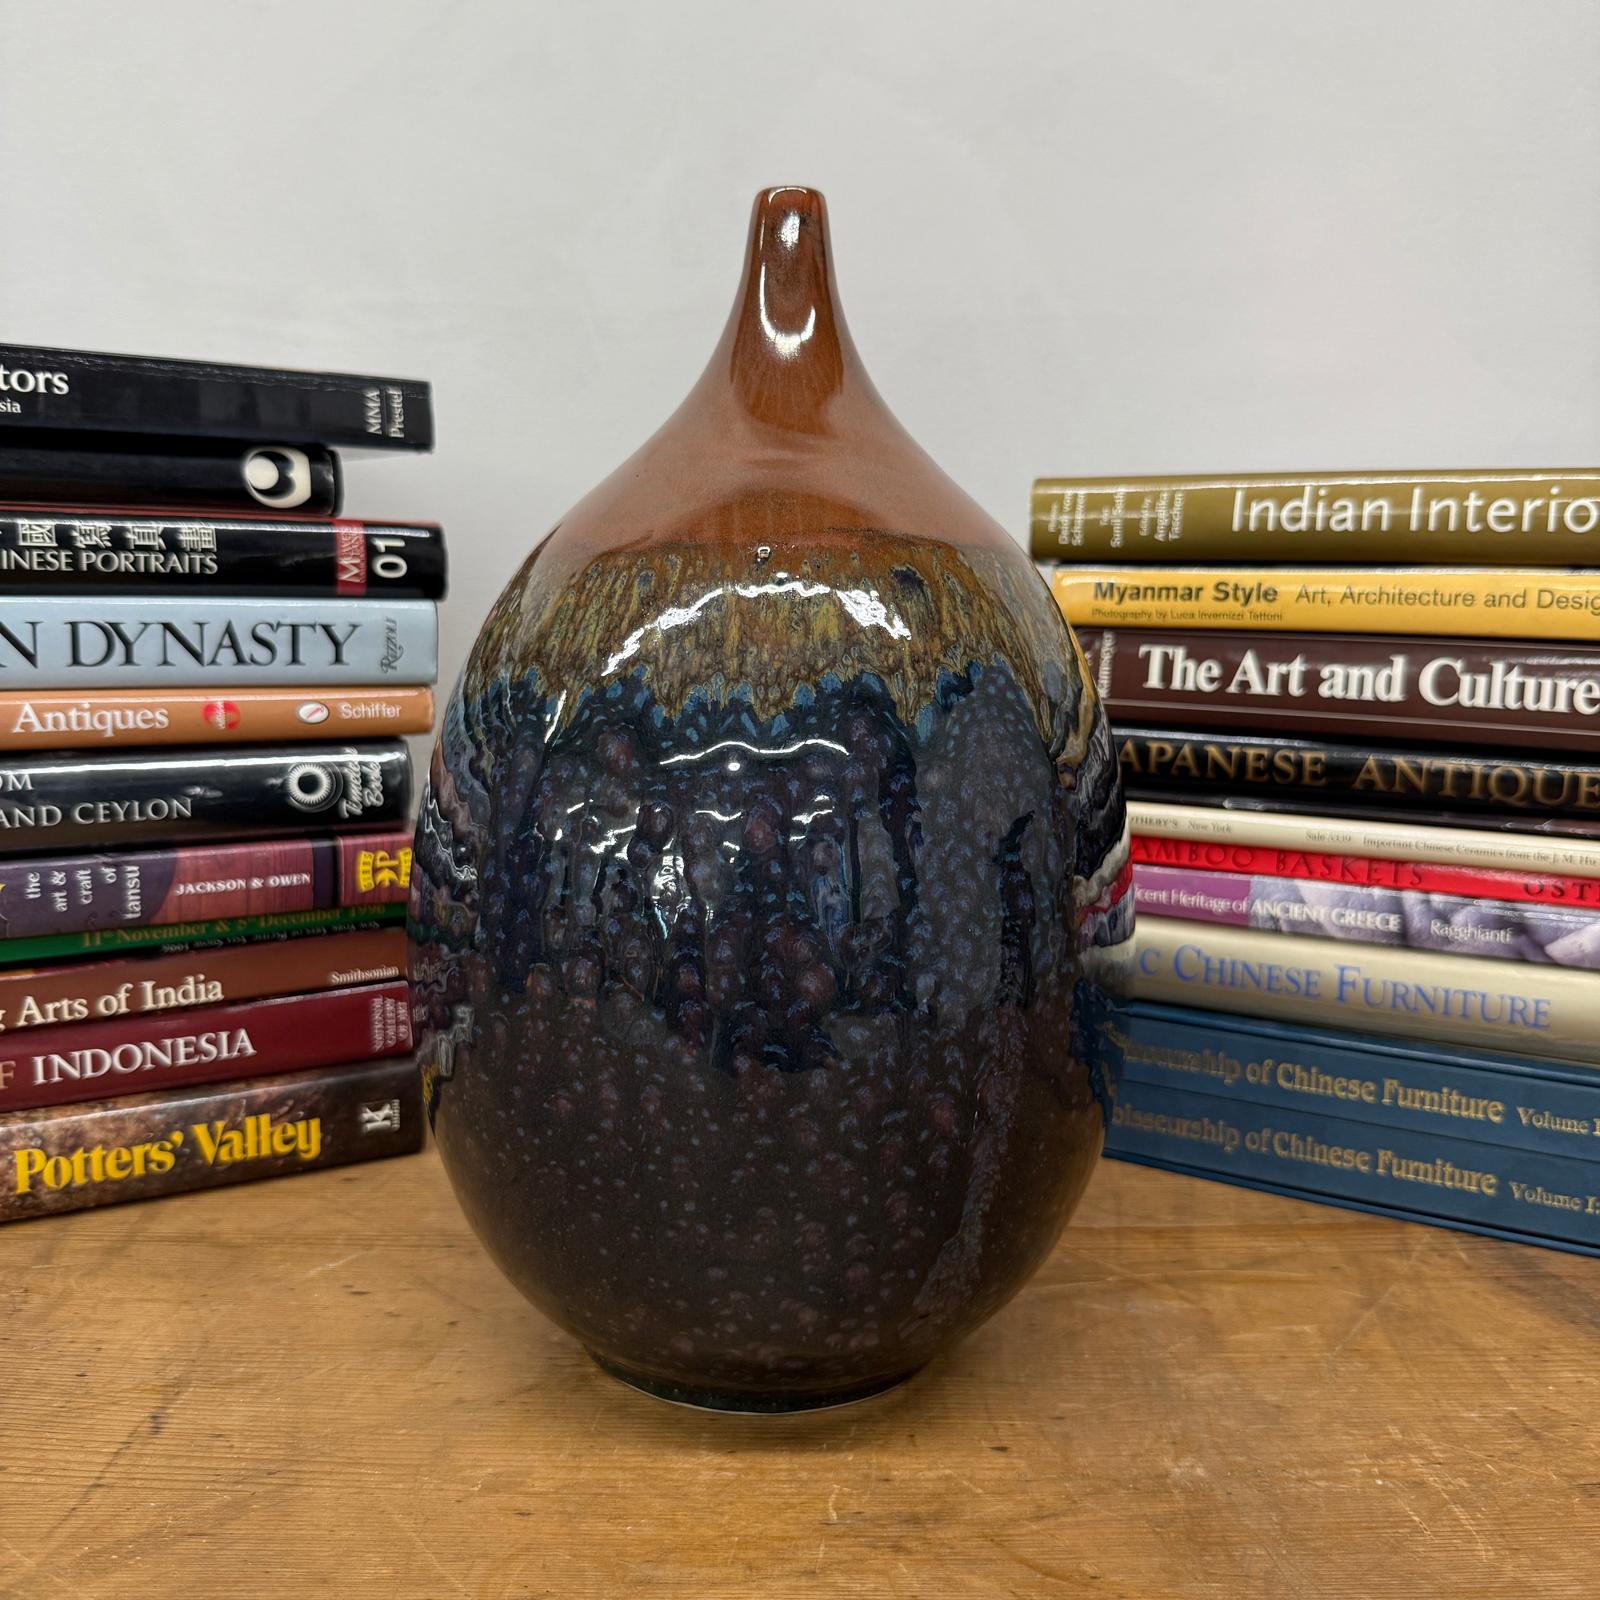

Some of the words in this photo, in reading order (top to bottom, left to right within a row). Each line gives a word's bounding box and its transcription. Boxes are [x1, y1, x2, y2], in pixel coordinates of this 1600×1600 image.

[0, 364, 69, 395] tors
[1232, 483, 1390, 533] Indian
[1409, 485, 1600, 534] Interio
[82, 549, 218, 575] PORTRAITS
[370, 537, 408, 579] 01
[1093, 581, 1204, 605] Myanmar
[1212, 581, 1278, 608] Style
[1295, 585, 1333, 607] Art,
[1341, 585, 1475, 609] Architecture
[1484, 588, 1527, 609] and
[1092, 608, 1151, 621] Photography
[1155, 609, 1167, 621] by
[1171, 610, 1195, 620] Luca
[66, 620, 362, 667] DYNASTY
[1138, 643, 1223, 692] The
[1225, 649, 1308, 698] Art
[1318, 655, 1406, 703] and
[1418, 658, 1600, 715] Culture
[12, 703, 169, 737] Antiques
[341, 701, 401, 719] Schiffer
[1119, 738, 1328, 787] APANESE
[0, 803, 62, 829] AND
[71, 798, 192, 825] CEYLON
[1363, 837, 1412, 849] Important
[1415, 841, 1455, 852] Chinese
[1457, 844, 1503, 856] Ceramics
[1506, 848, 1529, 859] from
[1533, 851, 1550, 862] the
[25, 871, 42, 900] the
[50, 870, 67, 886] &
[75, 869, 93, 905] craft
[100, 866, 117, 883] of
[175, 877, 246, 896] JACKSON
[251, 876, 265, 890] &
[268, 872, 311, 889] OWEN
[1275, 852, 1424, 886] BASKETS
[1523, 881, 1600, 903] OST
[50, 890, 68, 912] art
[123, 865, 143, 919] tansu
[116, 922, 206, 943] November
[214, 918, 231, 932] &
[259, 909, 340, 928] December
[1171, 888, 1231, 914] Heritage
[1232, 897, 1250, 913] of
[1251, 900, 1326, 929] ANCIENT
[1330, 908, 1401, 934] GREECE
[1430, 918, 1514, 945] Ragghianti
[331, 965, 399, 985] Smithsonian
[16, 996, 88, 1026] Arts
[98, 983, 134, 1017] of
[140, 973, 225, 1009] India
[33, 1028, 257, 1085] INDONESIA
[1246, 1058, 1275, 1084] of
[1276, 1062, 1376, 1104] Chinese
[1381, 1078, 1505, 1124] Furniture
[1517, 1106, 1589, 1135] Volume
[15, 1130, 185, 1195] Potters'
[194, 1113, 322, 1168] Valley
[1244, 1128, 1272, 1153] of
[1272, 1131, 1371, 1173] Chinese
[1376, 1149, 1498, 1196] Furniture
[1508, 1180, 1582, 1211] Volume
